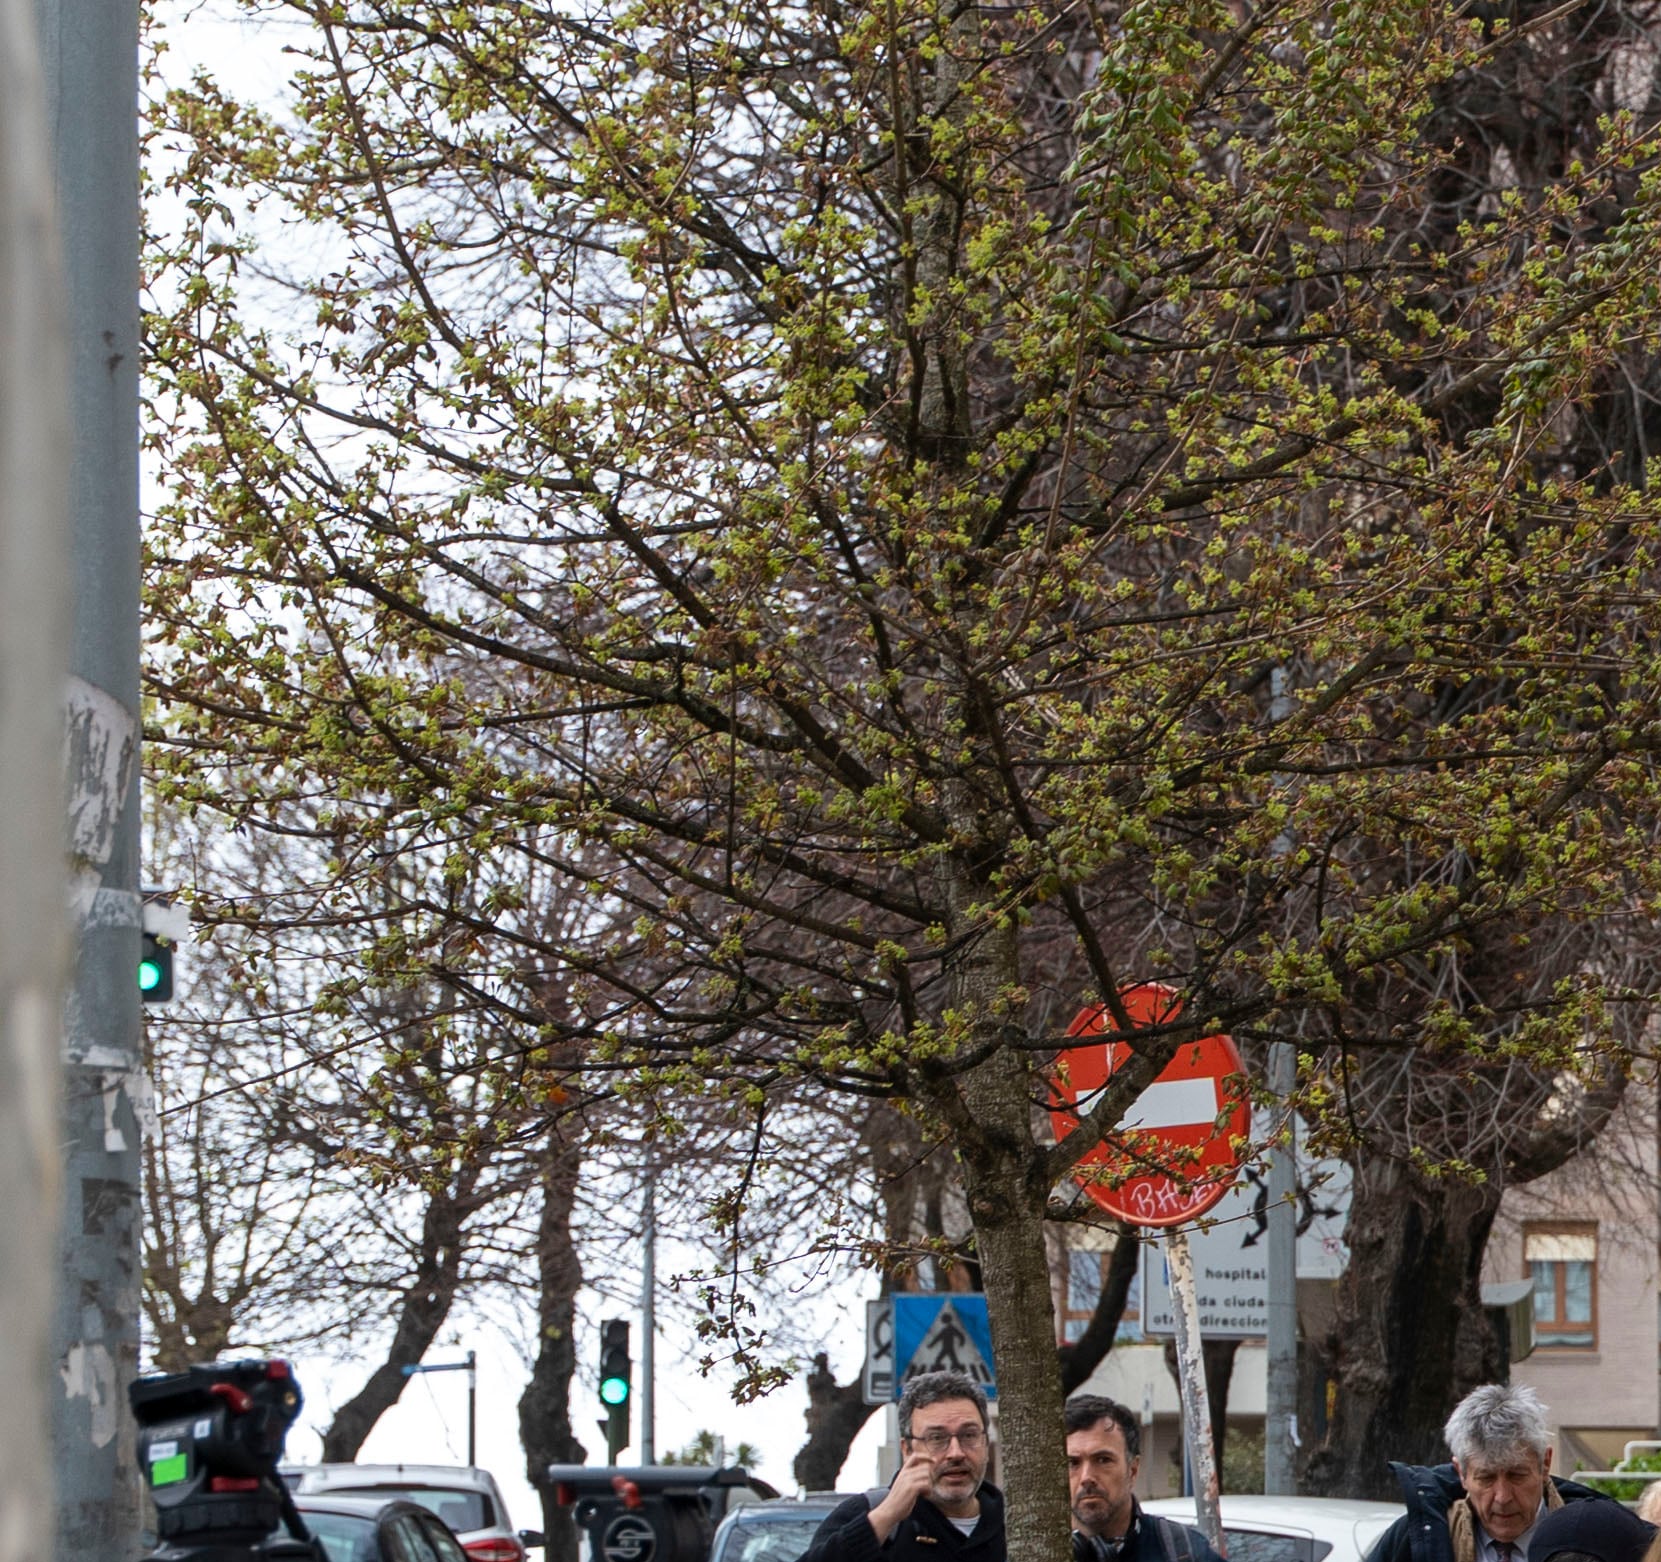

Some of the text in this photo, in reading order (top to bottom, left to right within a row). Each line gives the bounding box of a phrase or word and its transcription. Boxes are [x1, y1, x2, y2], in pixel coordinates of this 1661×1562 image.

[1205, 1267, 1266, 1281] hospital
[1224, 1296, 1266, 1307] ciuda
[1200, 1315, 1267, 1327] direccion
